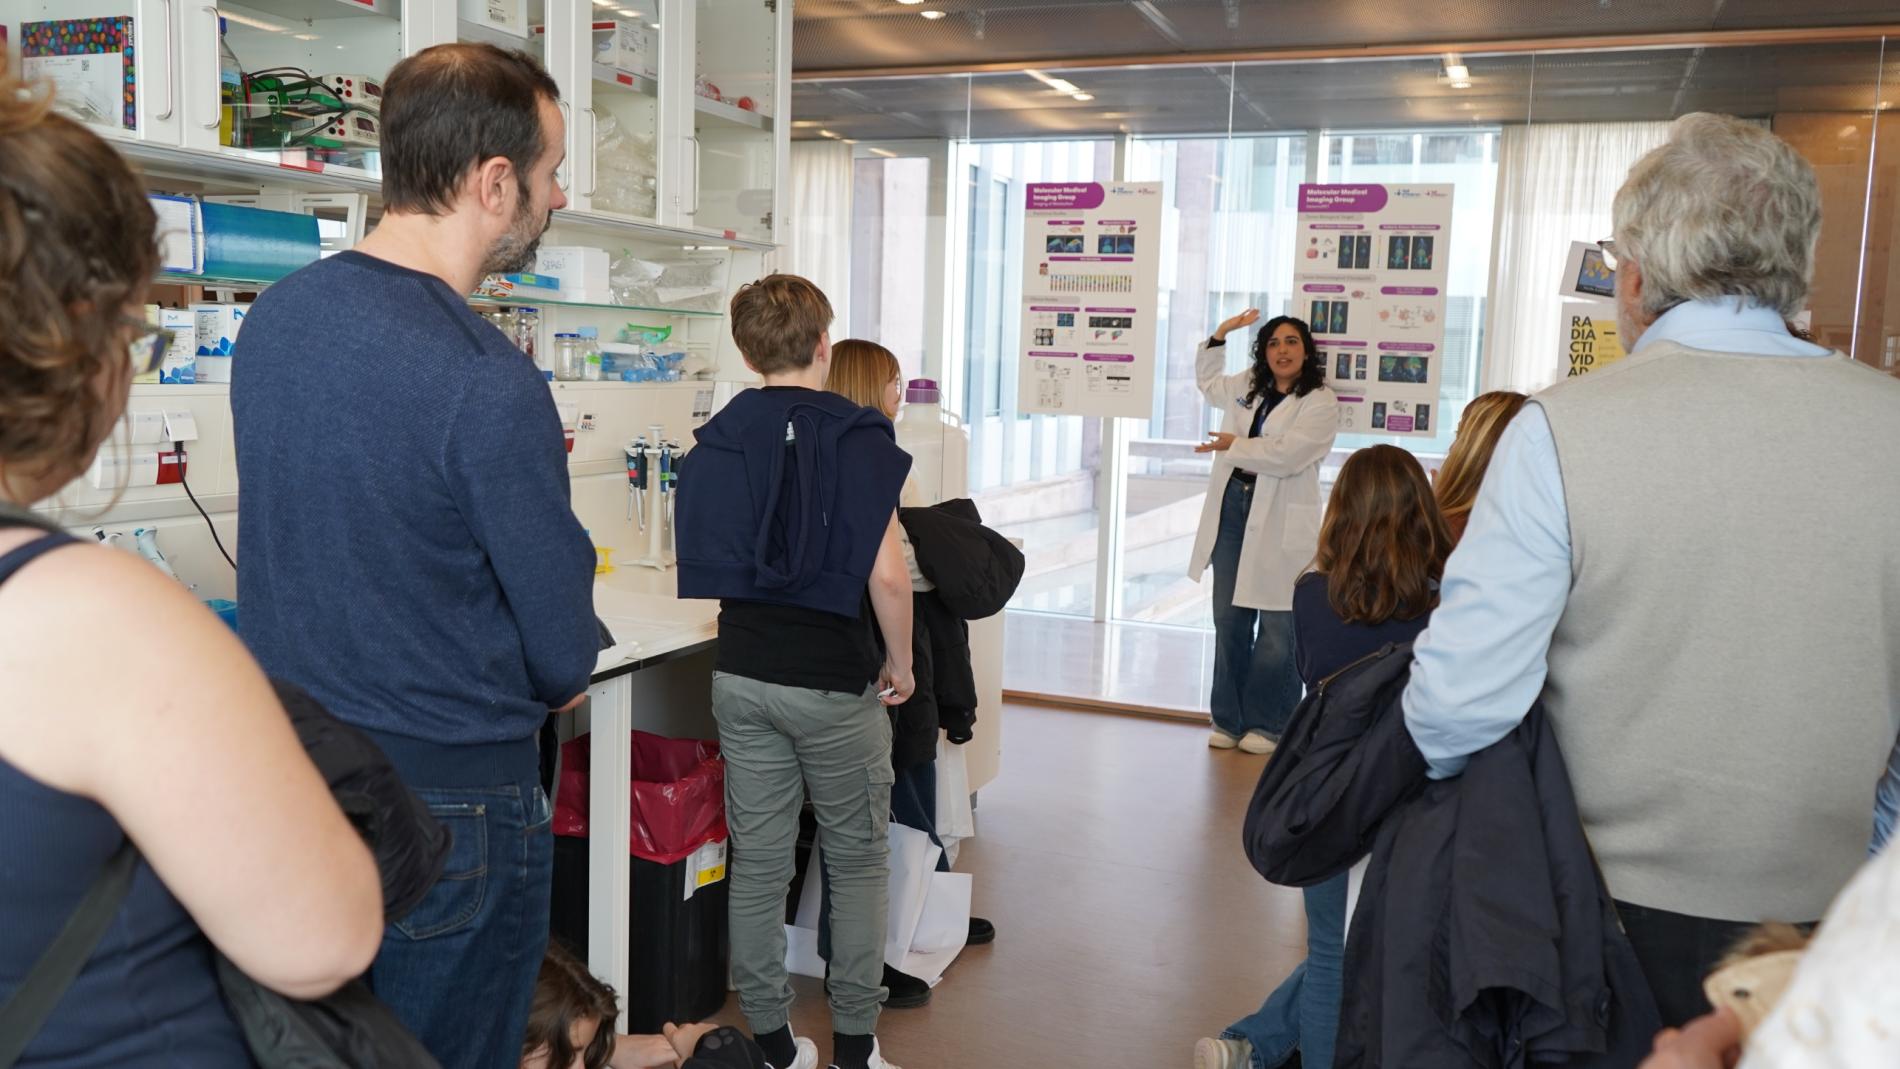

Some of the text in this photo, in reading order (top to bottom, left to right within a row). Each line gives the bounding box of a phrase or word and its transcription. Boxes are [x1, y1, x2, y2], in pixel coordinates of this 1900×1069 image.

[1033, 194, 1076, 202] Imaging Group
[1306, 196, 1355, 204] Imaging Group
[1572, 316, 1592, 327] RA
[1570, 329, 1596, 340] DIA
[1569, 341, 1593, 353] CTI
[1568, 354, 1594, 366] VID
